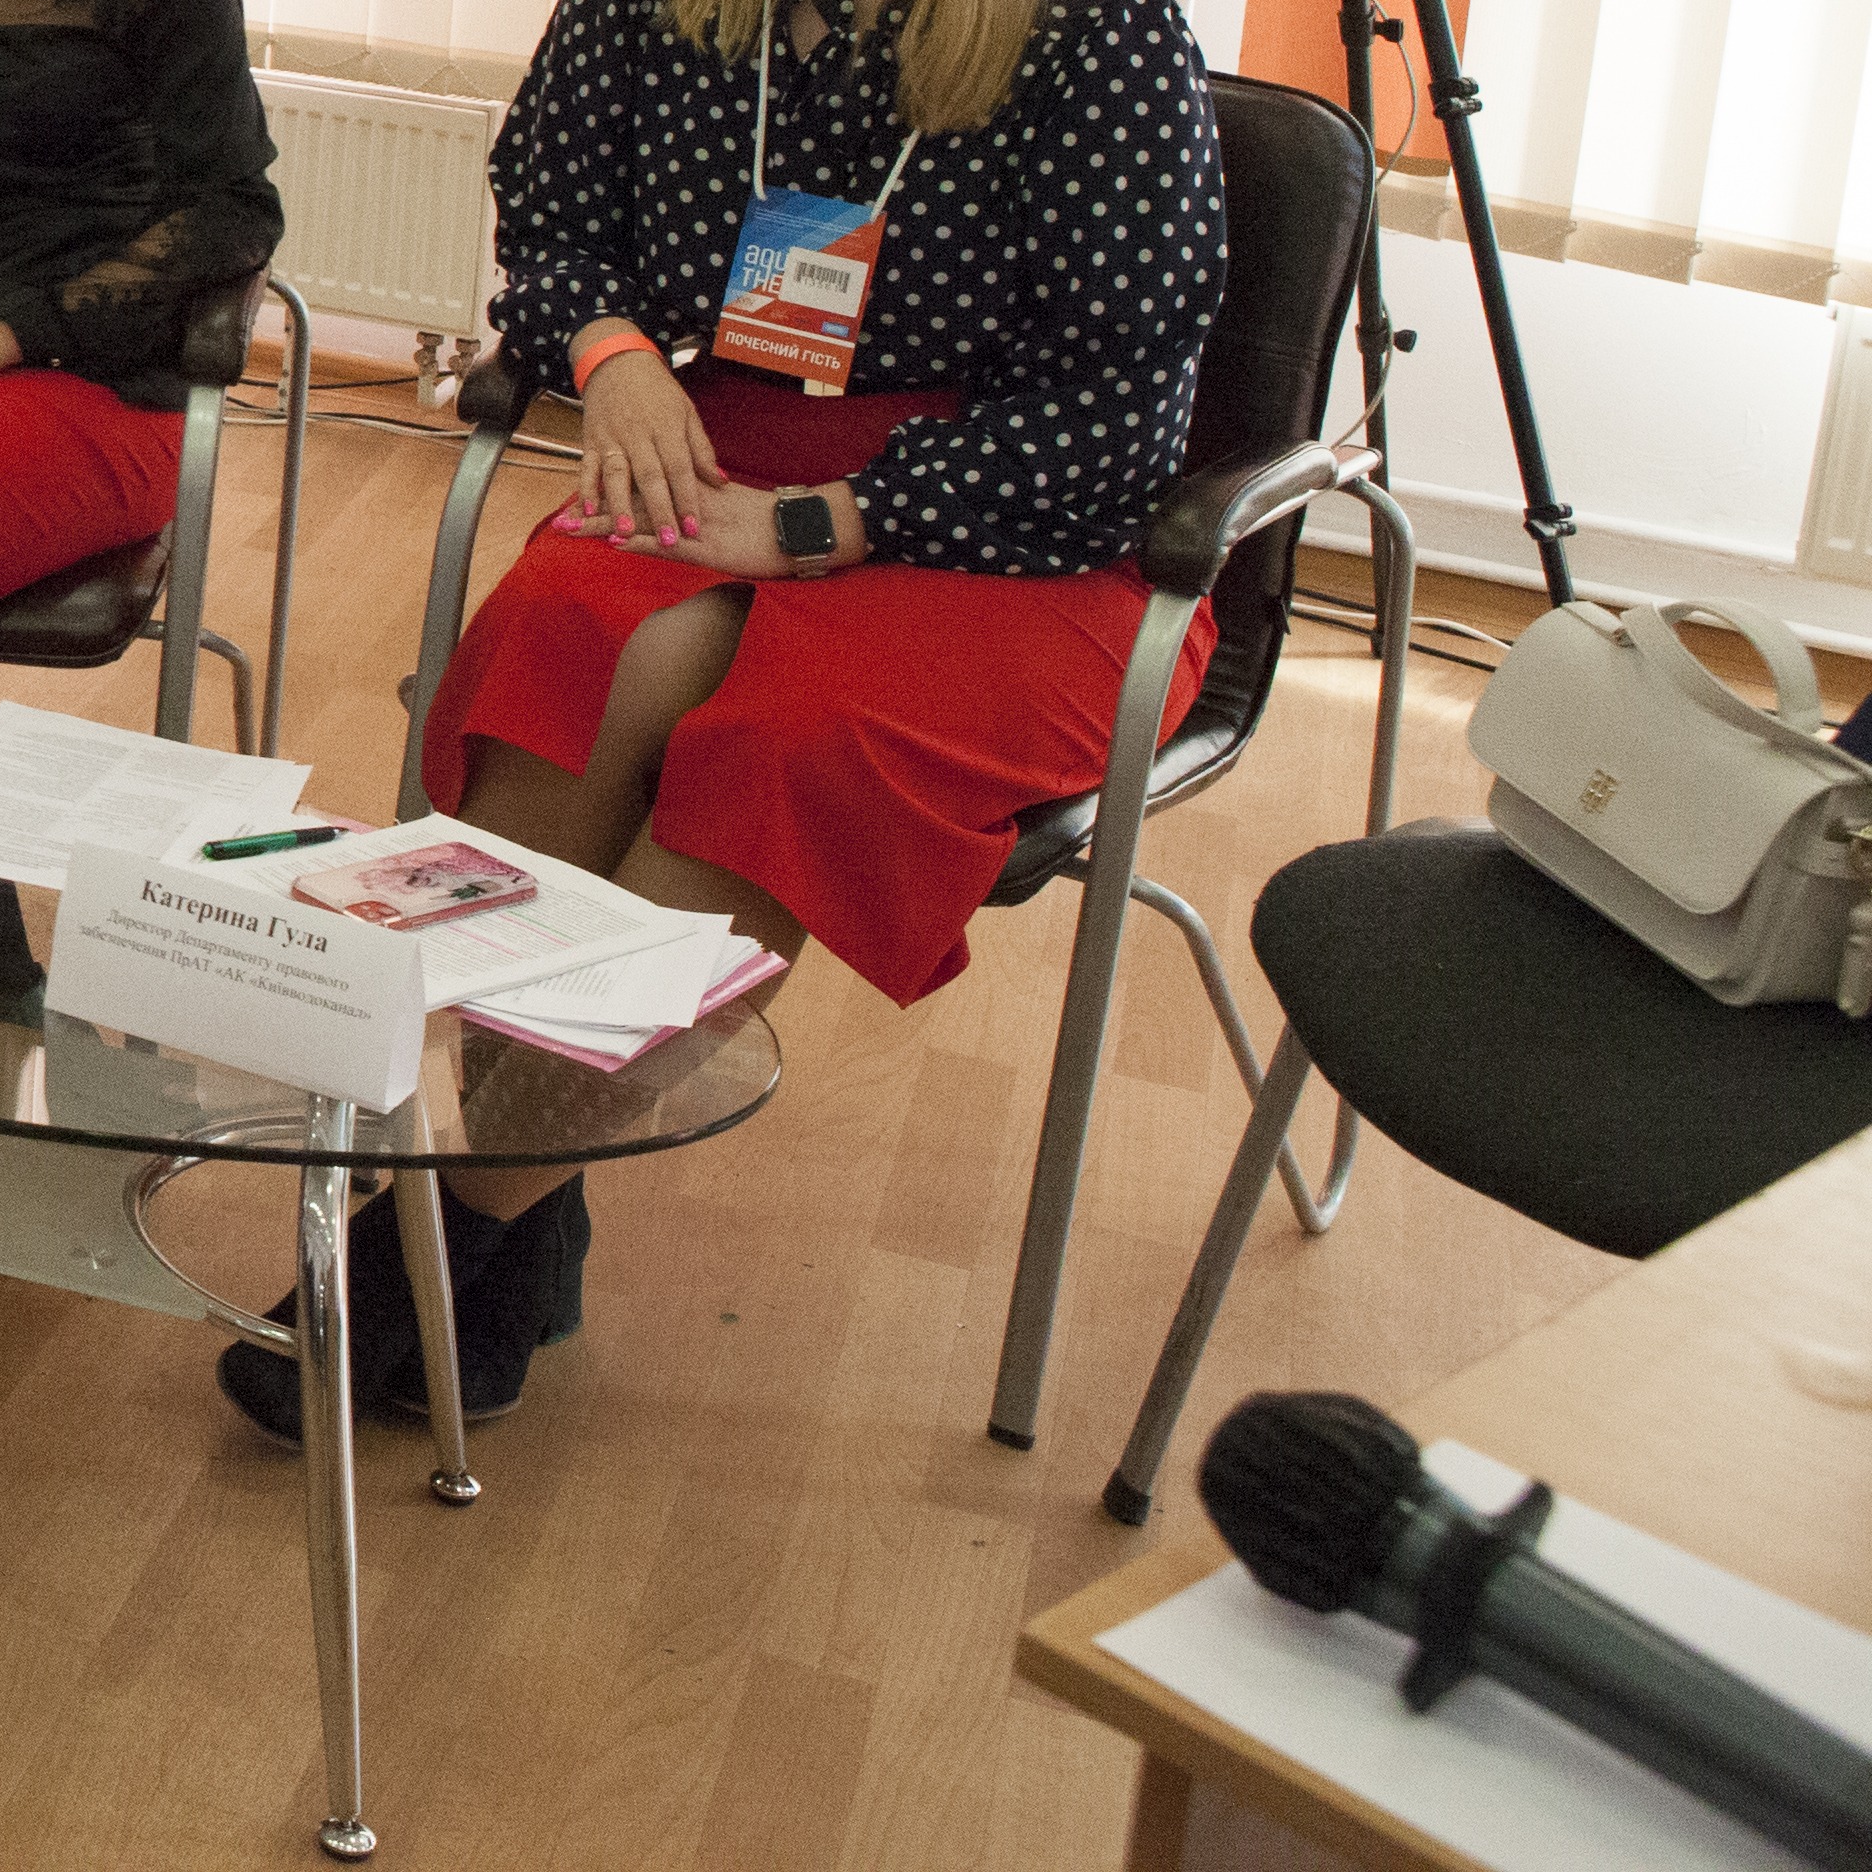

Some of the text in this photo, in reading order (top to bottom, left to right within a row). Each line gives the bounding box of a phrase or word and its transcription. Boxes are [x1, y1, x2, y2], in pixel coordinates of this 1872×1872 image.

[740, 266, 785, 296] THE
[744, 243, 790, 281] aqu
[723, 329, 841, 370] ПОЧЕСНИЙ ГІСТЬ
[139, 878, 329, 955] Катерина Гула
[79, 925, 168, 961] забезпечення
[169, 946, 213, 974] ПрАТ
[214, 964, 249, 986] «АК
[106, 909, 351, 992] Директор Департаменту правового
